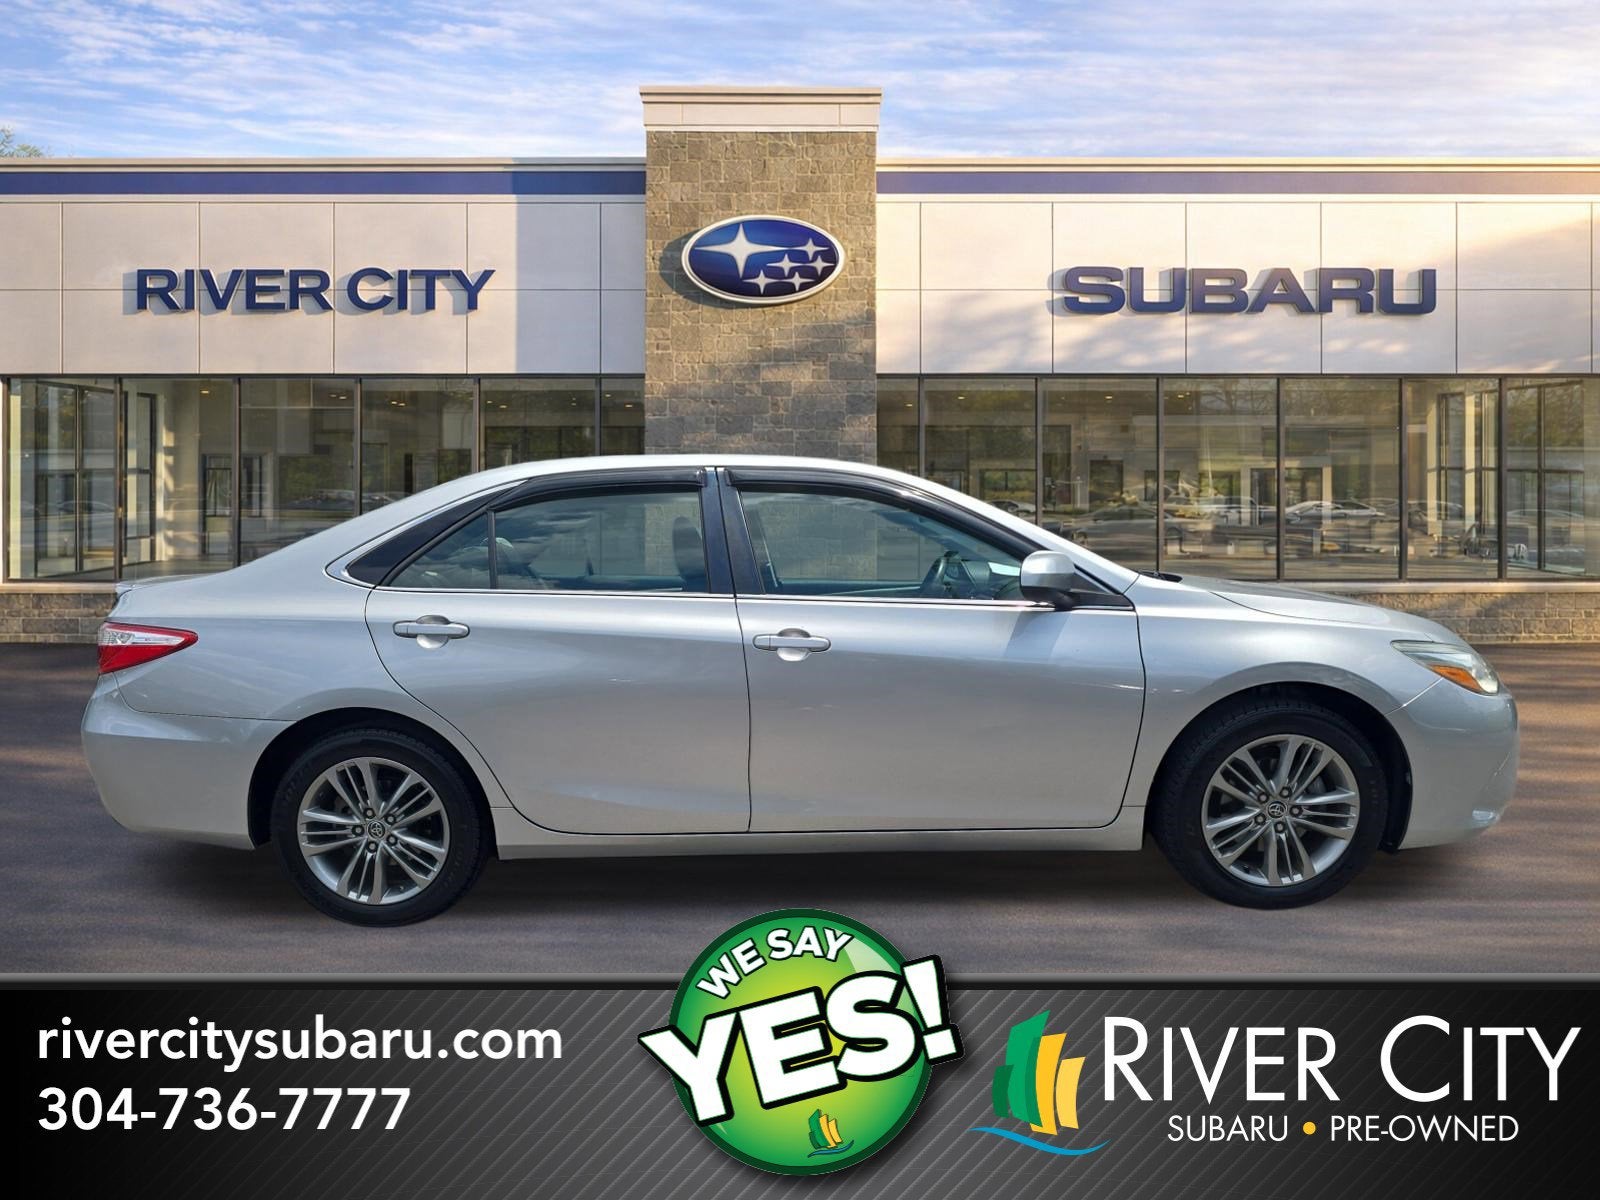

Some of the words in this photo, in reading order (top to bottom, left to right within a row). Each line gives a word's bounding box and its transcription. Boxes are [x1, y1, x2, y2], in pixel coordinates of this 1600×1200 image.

[136, 269, 332, 312] RIVER
[347, 267, 496, 312] CITY
[1062, 266, 1438, 315] SUBARU
